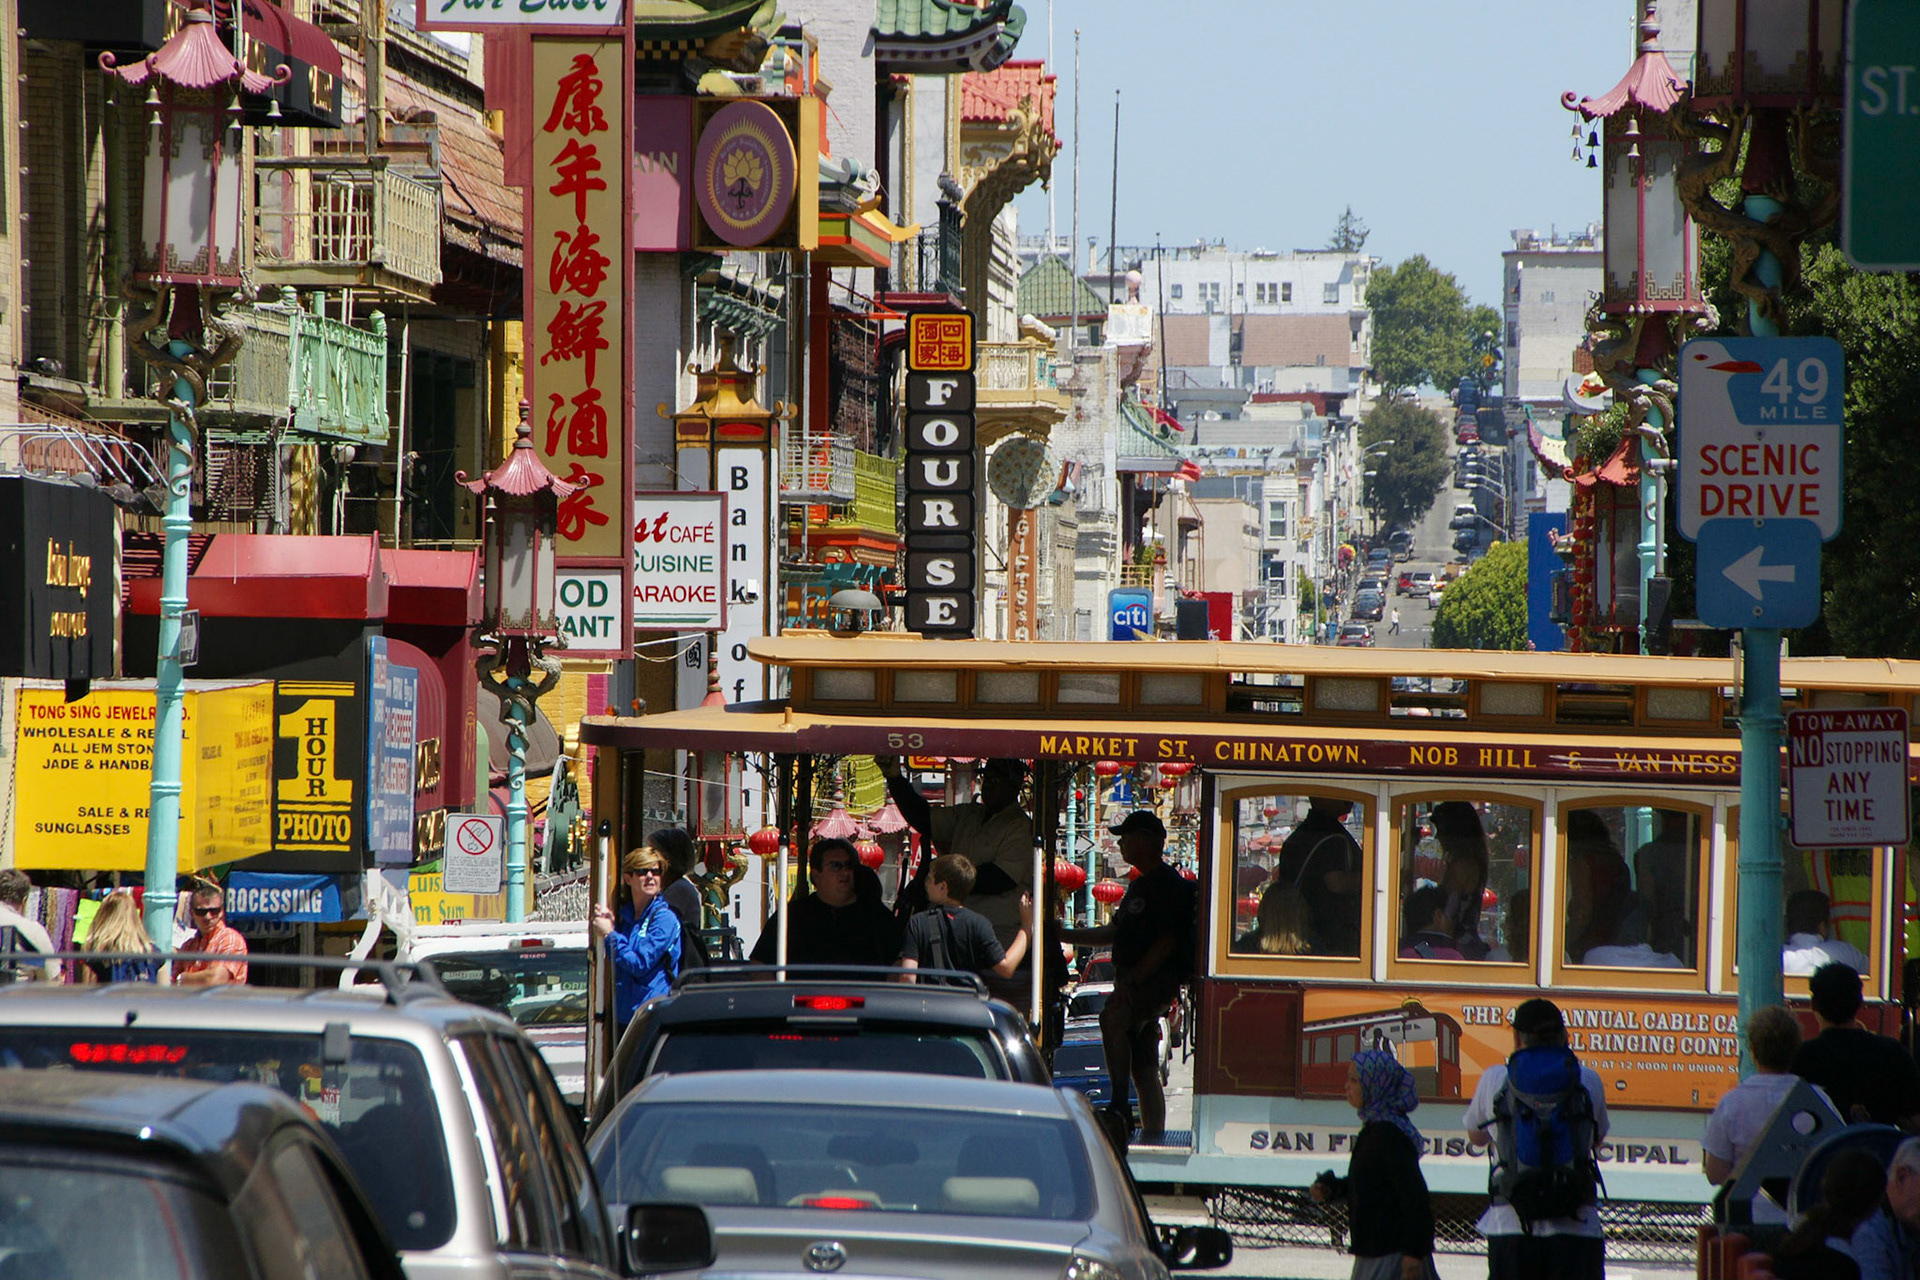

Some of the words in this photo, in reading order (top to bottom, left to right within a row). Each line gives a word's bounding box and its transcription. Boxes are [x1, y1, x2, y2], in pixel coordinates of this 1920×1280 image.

[1860, 65, 1919, 116] ST.
[1760, 357, 1829, 404] 49
[1760, 405, 1828, 420] MILE
[1700, 444, 1821, 476] SCENIC
[1700, 484, 1821, 516] DRIVE
[635, 511, 669, 543] st
[670, 521, 715, 543] CAFÉ
[560, 579, 608, 607] OD
[634, 585, 717, 603] ARAOKE
[1113, 606, 1147, 626] citi
[29, 704, 66, 720] TONG
[70, 705, 101, 720] SING
[105, 706, 157, 721] JEWELR
[1796, 713, 1898, 731] TOW-AWAY
[23, 727, 116, 739] WHOLESALE
[120, 728, 132, 739] &
[52, 743, 79, 754] ALL
[83, 743, 113, 754] JEM
[116, 743, 154, 755] STON
[304, 717, 328, 798] HOUR
[887, 733, 925, 750] 53
[1040, 736, 1139, 757] MARKET
[1409, 746, 1459, 766] NOB
[1479, 748, 1537, 768] HILL
[1615, 752, 1661, 773] VAN
[1671, 753, 1738, 774] NESS
[1793, 735, 1821, 765] NO
[1825, 740, 1901, 764] STOPPING
[42, 759, 80, 770] JADE
[84, 759, 95, 770] &
[99, 759, 153, 771] HANDB
[1828, 771, 1871, 794] ANY
[78, 806, 114, 818] SALE
[119, 807, 130, 818] &
[1824, 799, 1875, 821] TIME
[34, 822, 131, 836] SUNGLASSES
[277, 812, 352, 843] PHOTO
[226, 887, 323, 914] ROCESSING
[1462, 1006, 1501, 1025] THE
[1561, 1009, 1640, 1030] ANNUAL
[1643, 1011, 1709, 1032] CABLE
[1713, 1014, 1738, 1033] CA
[1589, 1033, 1676, 1055] RINGING
[1601, 1060, 1615, 1069] AT
[1636, 1061, 1668, 1071] NOON
[1671, 1063, 1685, 1072] IN
[1688, 1064, 1724, 1073] UNION
[1250, 1131, 1316, 1152] SAN
